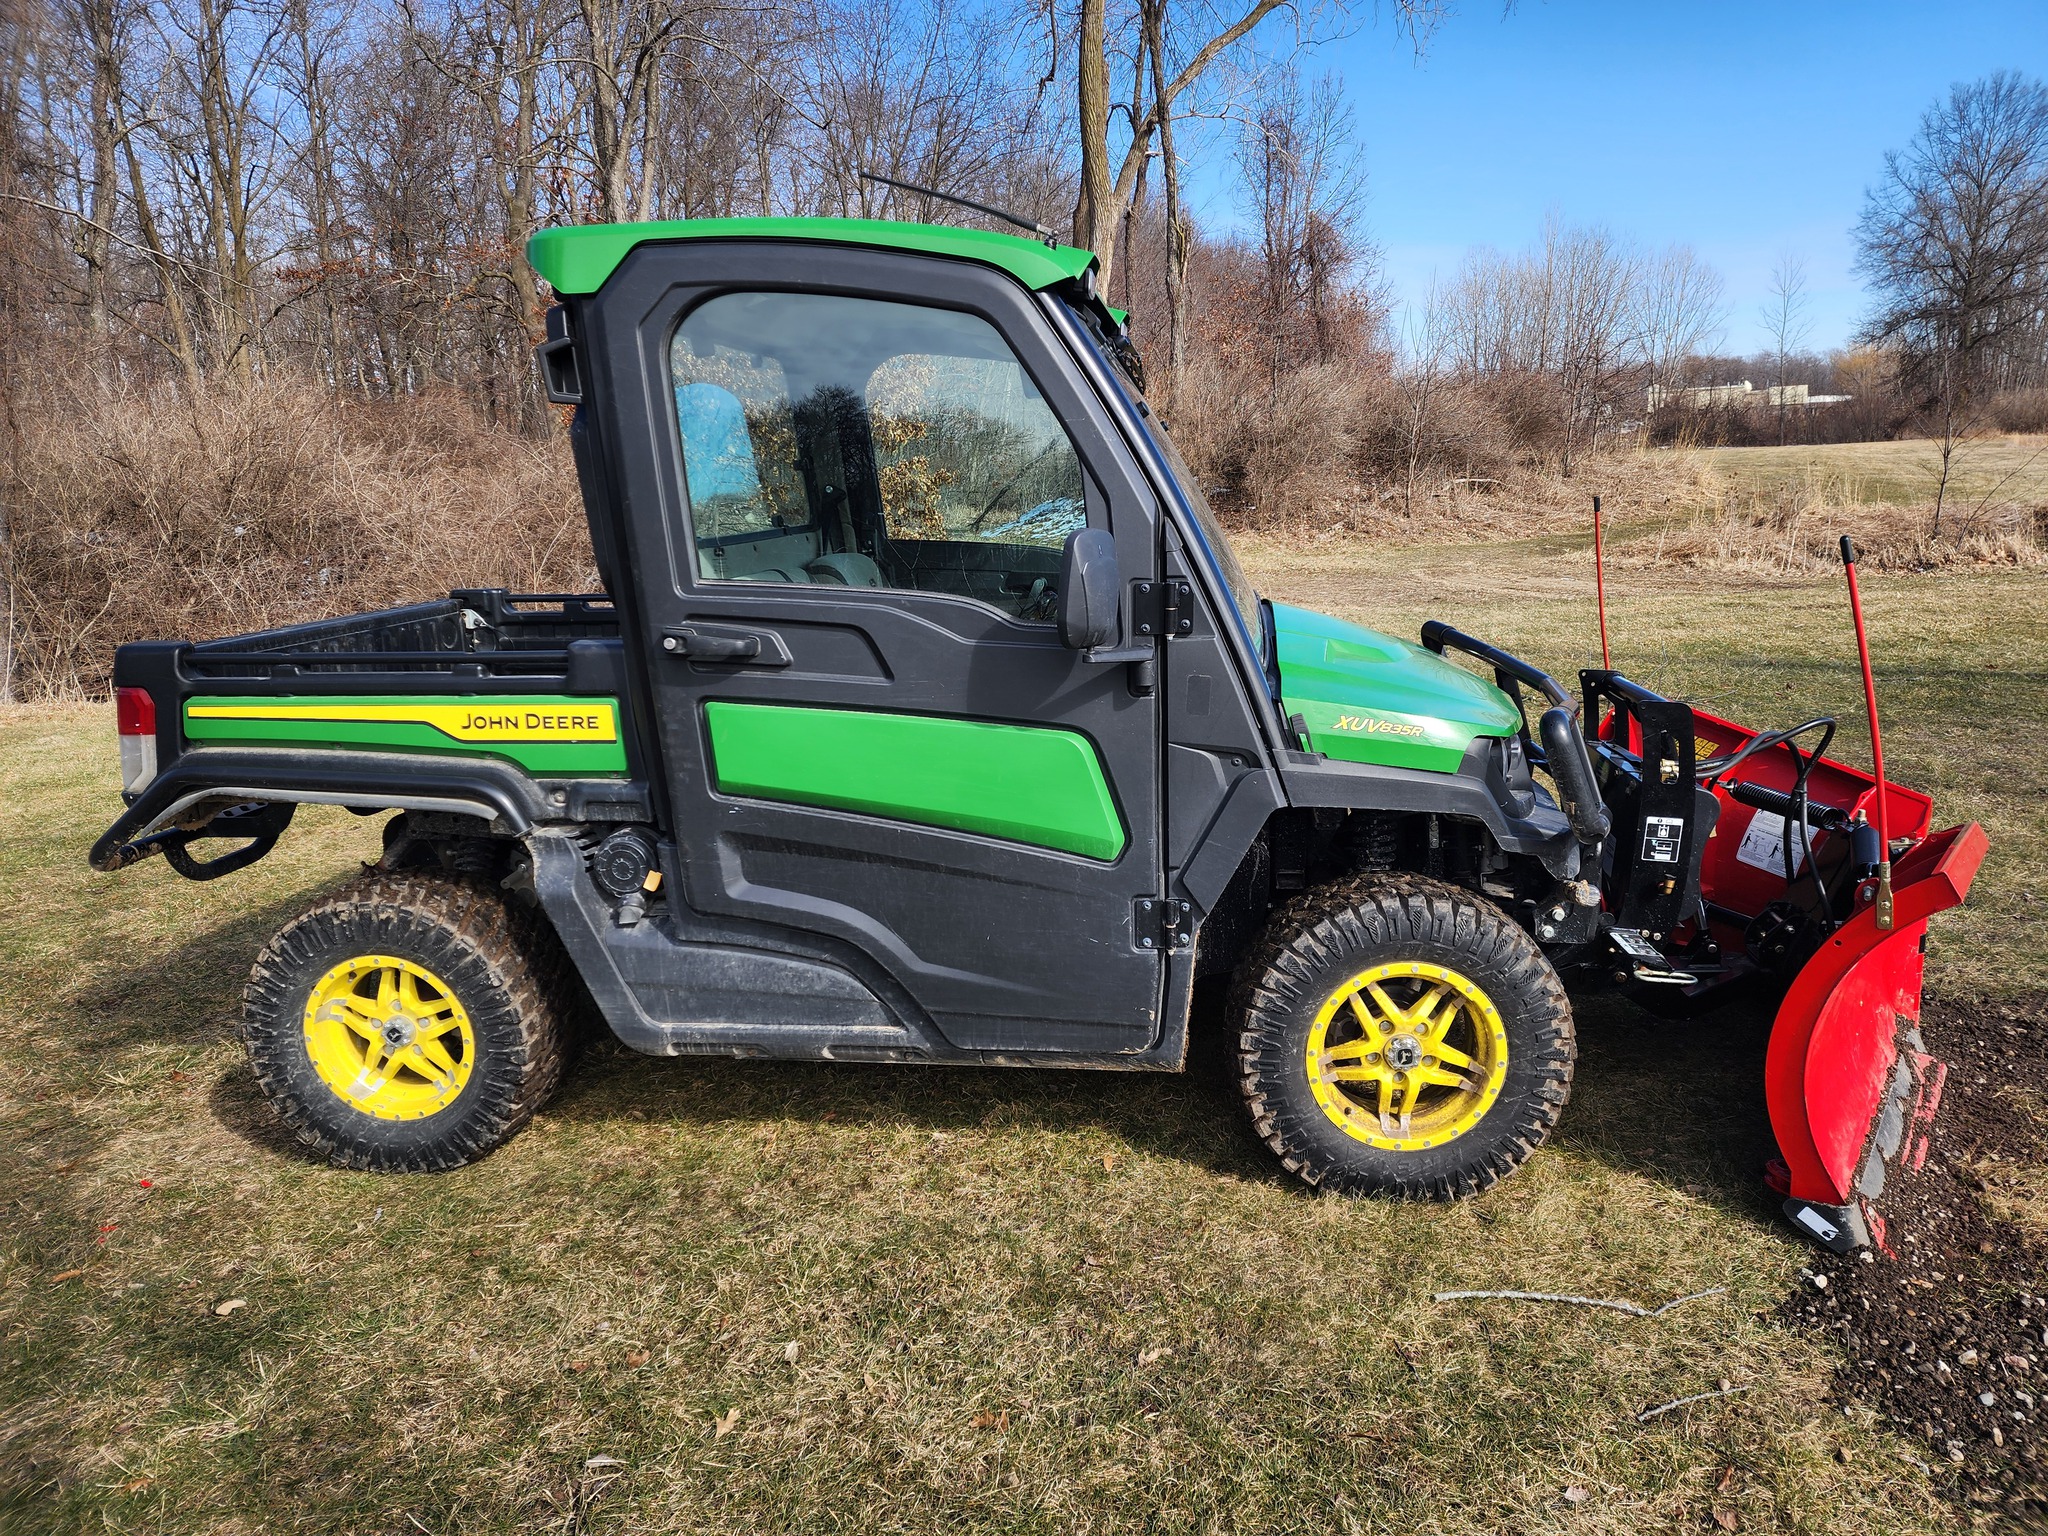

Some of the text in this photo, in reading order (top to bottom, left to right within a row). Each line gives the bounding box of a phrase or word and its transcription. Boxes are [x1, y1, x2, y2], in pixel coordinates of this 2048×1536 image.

[461, 713, 600, 730] JOHN DEERE
[1331, 715, 1424, 737] XUV835R
